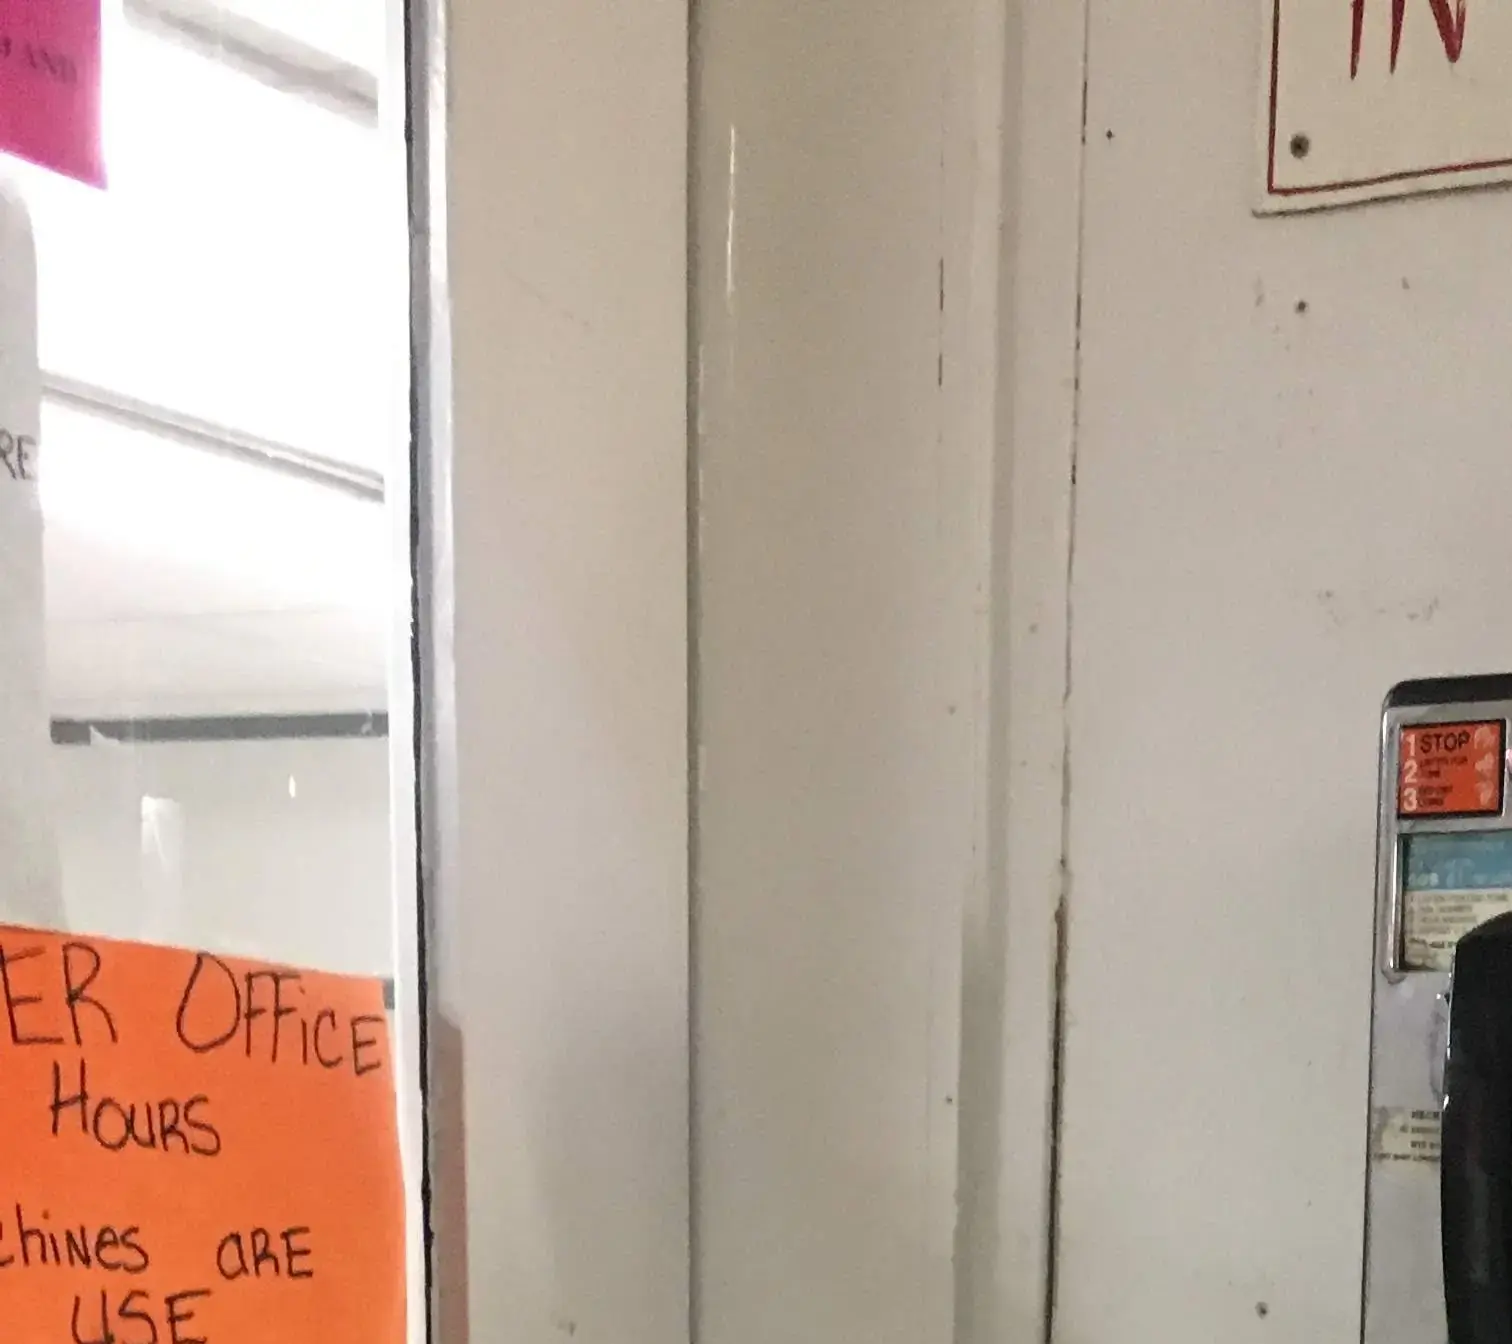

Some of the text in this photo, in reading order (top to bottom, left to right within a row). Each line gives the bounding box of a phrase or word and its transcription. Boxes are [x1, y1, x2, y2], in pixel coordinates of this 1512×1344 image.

[1420, 730, 1471, 753] STOP
[1403, 759, 1418, 783] 2
[1403, 787, 1418, 811] 3
[0, 942, 118, 1048] ER
